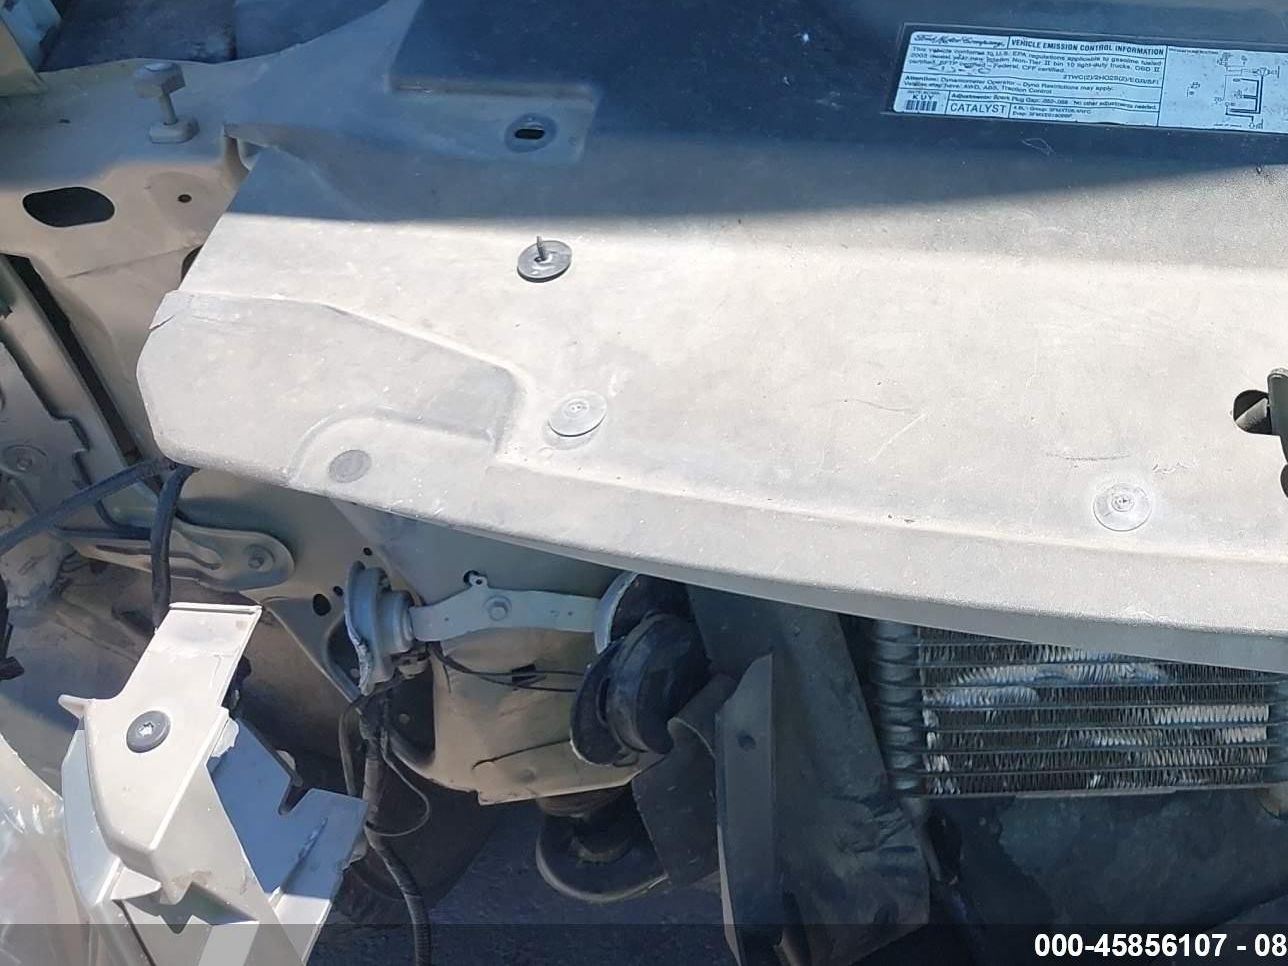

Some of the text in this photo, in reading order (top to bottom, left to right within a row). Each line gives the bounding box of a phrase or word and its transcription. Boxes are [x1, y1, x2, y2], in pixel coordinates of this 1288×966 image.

[1011, 39, 1041, 48] VEHICLE
[1043, 43, 1078, 51] EMISSION
[1080, 43, 1113, 52] CONTROL
[1115, 45, 1164, 55] INFORMATION
[1111, 57, 1139, 65] gasoline
[950, 103, 1007, 114] CATALYST
